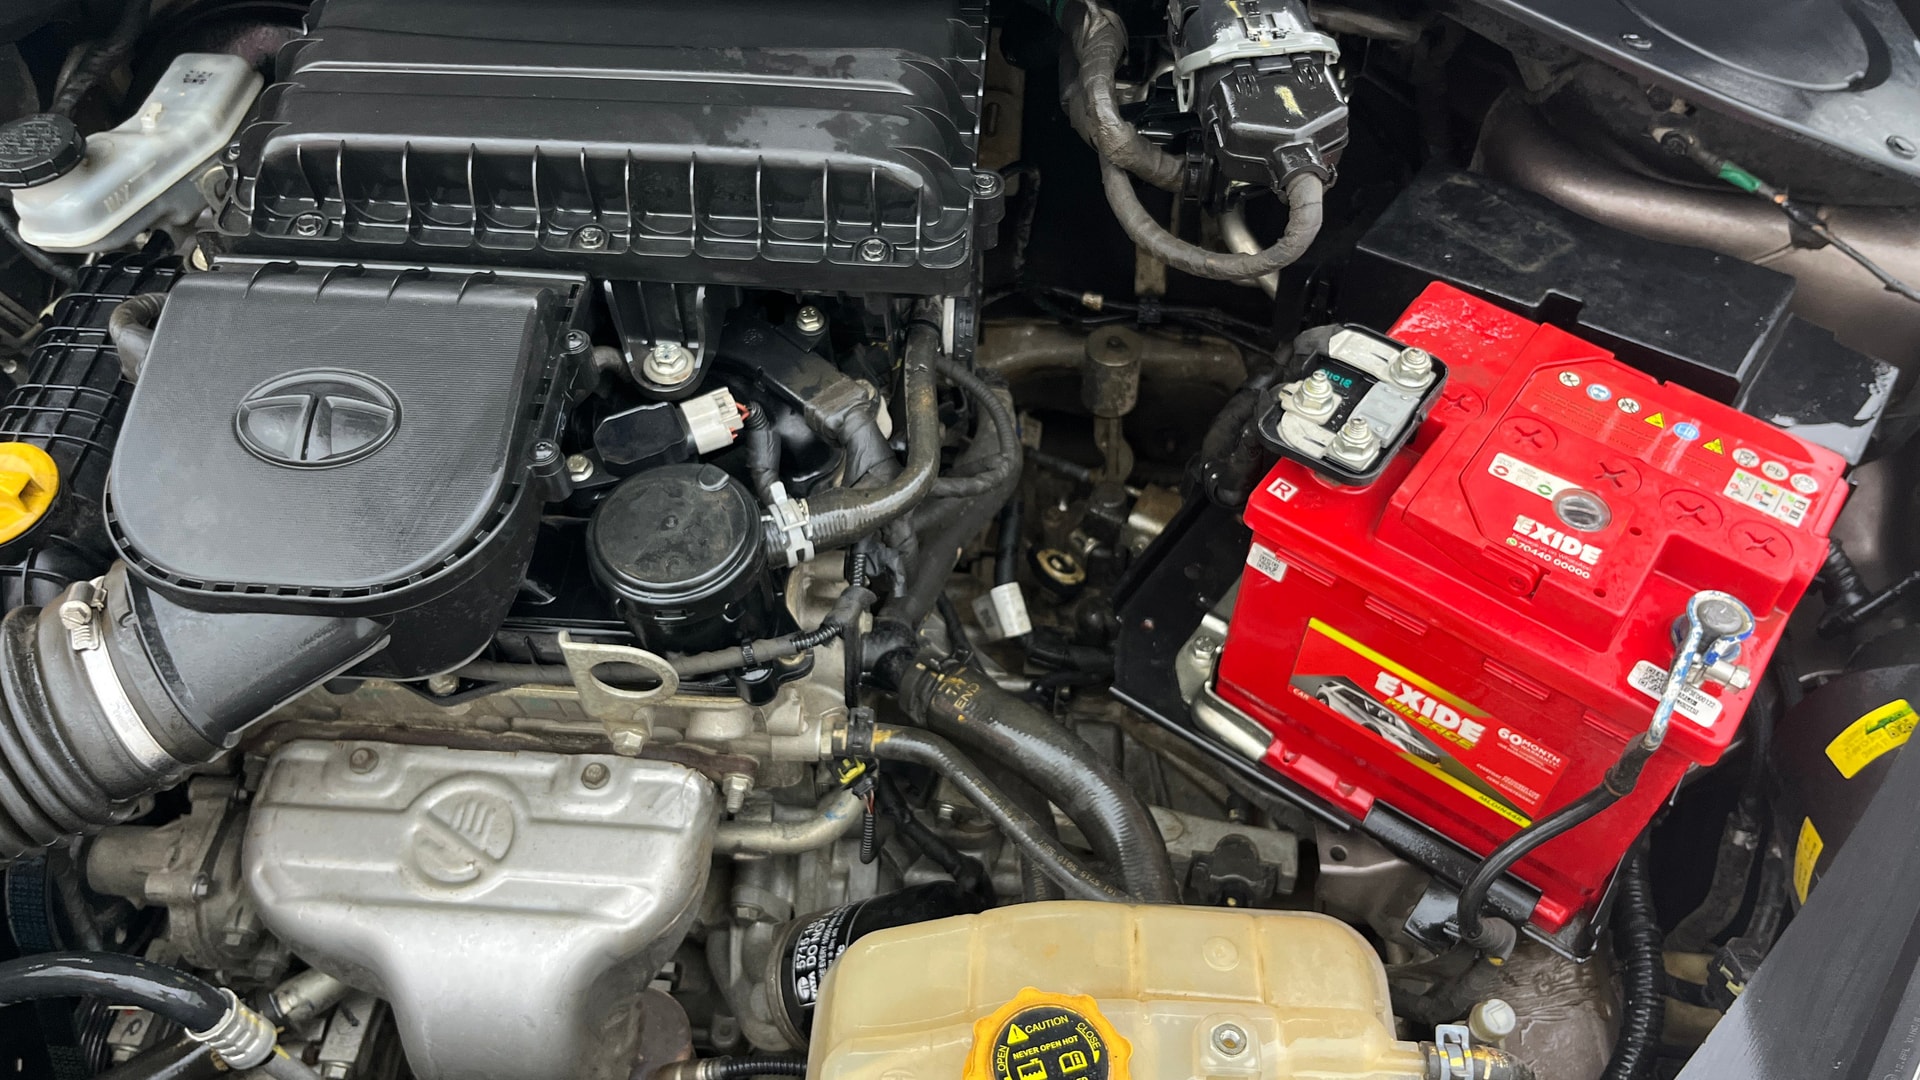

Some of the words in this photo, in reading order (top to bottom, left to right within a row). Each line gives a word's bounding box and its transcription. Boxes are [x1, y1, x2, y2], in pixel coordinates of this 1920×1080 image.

[1765, 464, 1784, 478] Pb
[1272, 481, 1292, 498] R
[1512, 514, 1603, 566] EXIDE
[1518, 541, 1552, 562] 70440
[1553, 558, 1590, 579] 00000
[1292, 688, 1310, 701] CAR
[1373, 671, 1486, 746] EXIDE
[1384, 697, 1476, 750] MILEAGE
[1497, 727, 1523, 745] 60
[1520, 738, 1561, 763] MONTH
[811, 918, 829, 942] NOT
[806, 944, 818, 967] DO
[1025, 1015, 1069, 1034] CAUTION
[1077, 1022, 1102, 1051] CLOSE
[997, 1044, 1009, 1072] OPEN
[1013, 1046, 1040, 1060] NEVER
[1040, 1041, 1062, 1052] OPEN
[1061, 1035, 1079, 1048] HOT
